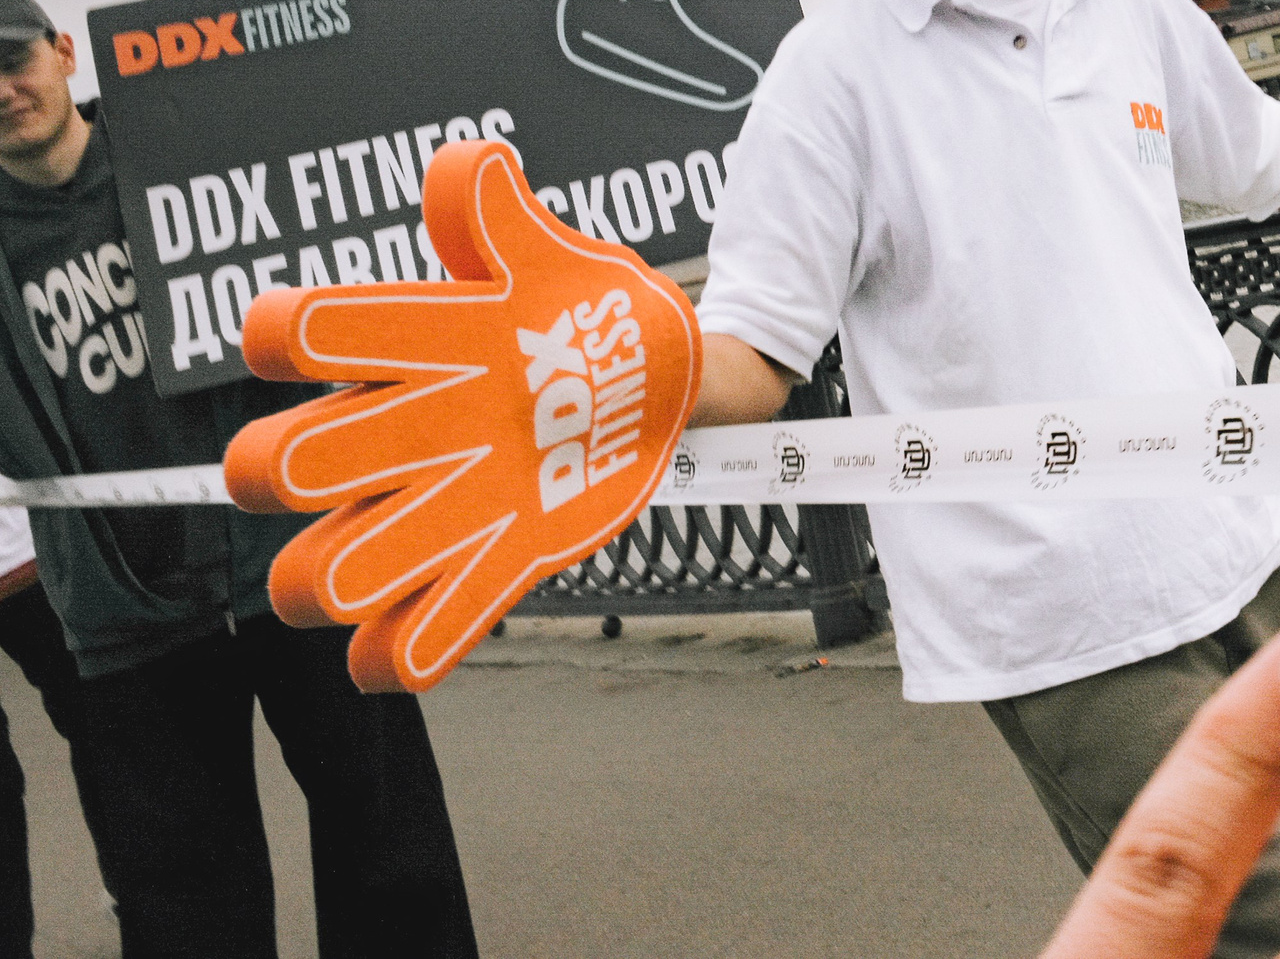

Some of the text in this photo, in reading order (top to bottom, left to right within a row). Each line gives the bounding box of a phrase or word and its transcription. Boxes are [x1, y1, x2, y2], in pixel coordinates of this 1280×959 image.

[112, 12, 245, 76] DDX
[1130, 102, 1165, 135] DDX
[146, 162, 281, 265] DDX
[22, 239, 137, 378] CONC
[79, 310, 150, 394] CU
[516, 309, 588, 514] DDX
[574, 289, 646, 487] FITNESS
